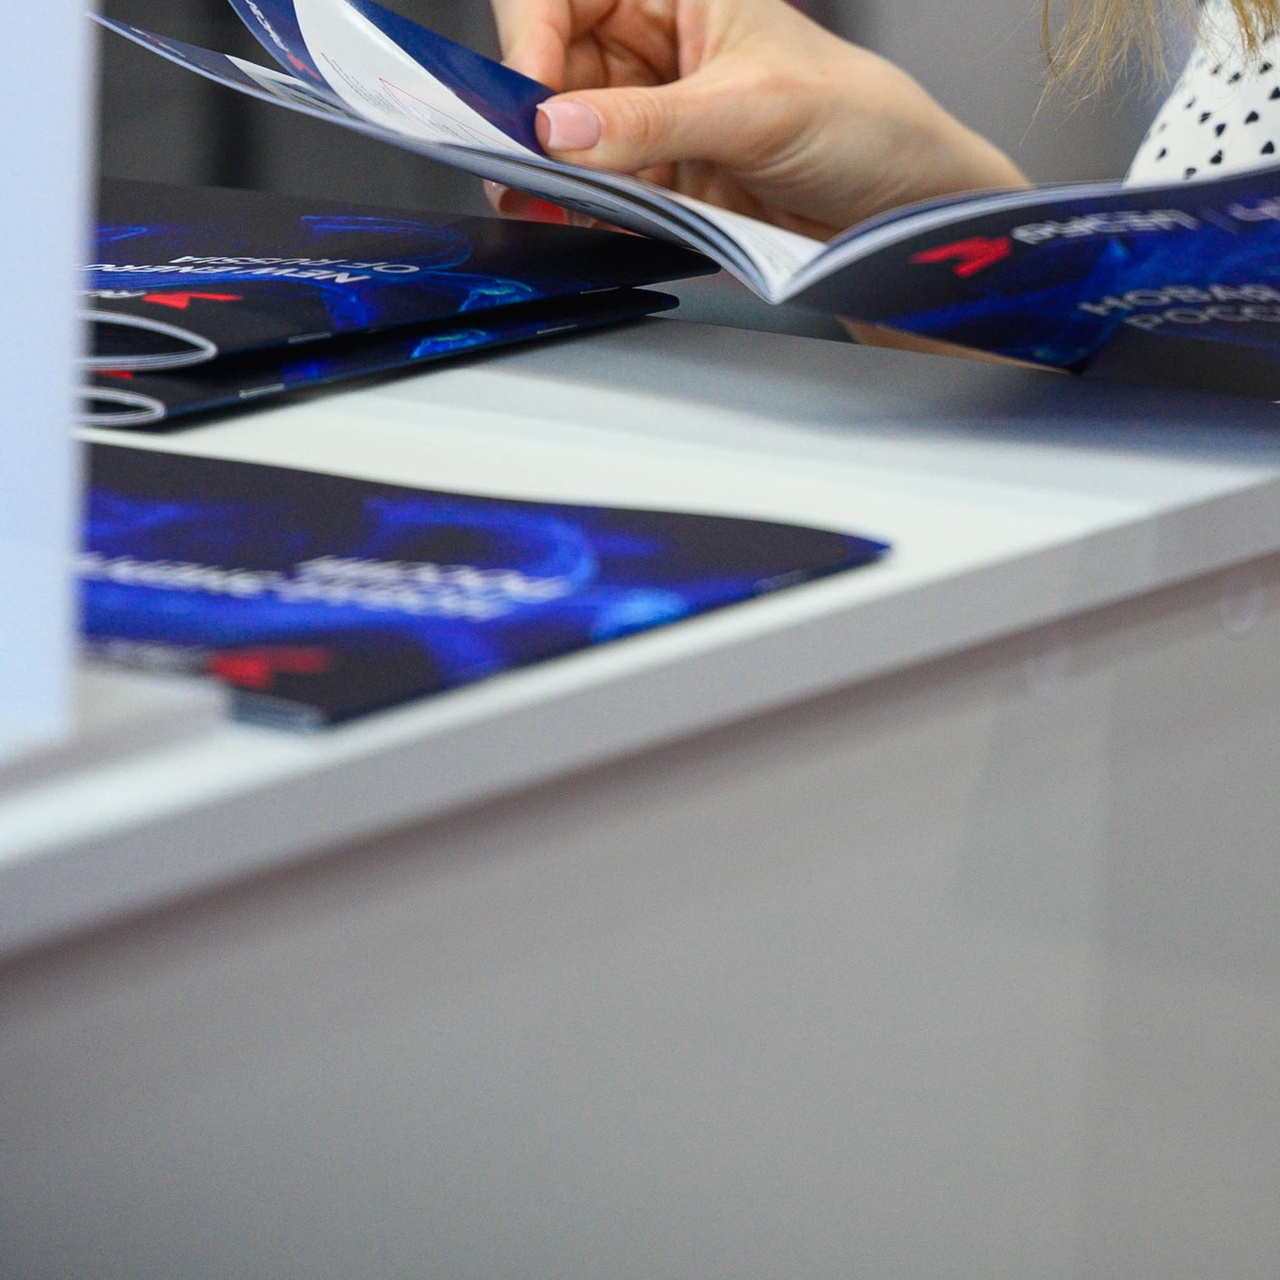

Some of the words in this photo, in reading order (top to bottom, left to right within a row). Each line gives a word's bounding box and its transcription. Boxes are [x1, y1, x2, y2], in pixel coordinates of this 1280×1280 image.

[168, 255, 348, 267] RUSSIA
[338, 261, 420, 274] OF
[232, 266, 373, 284] NEW
